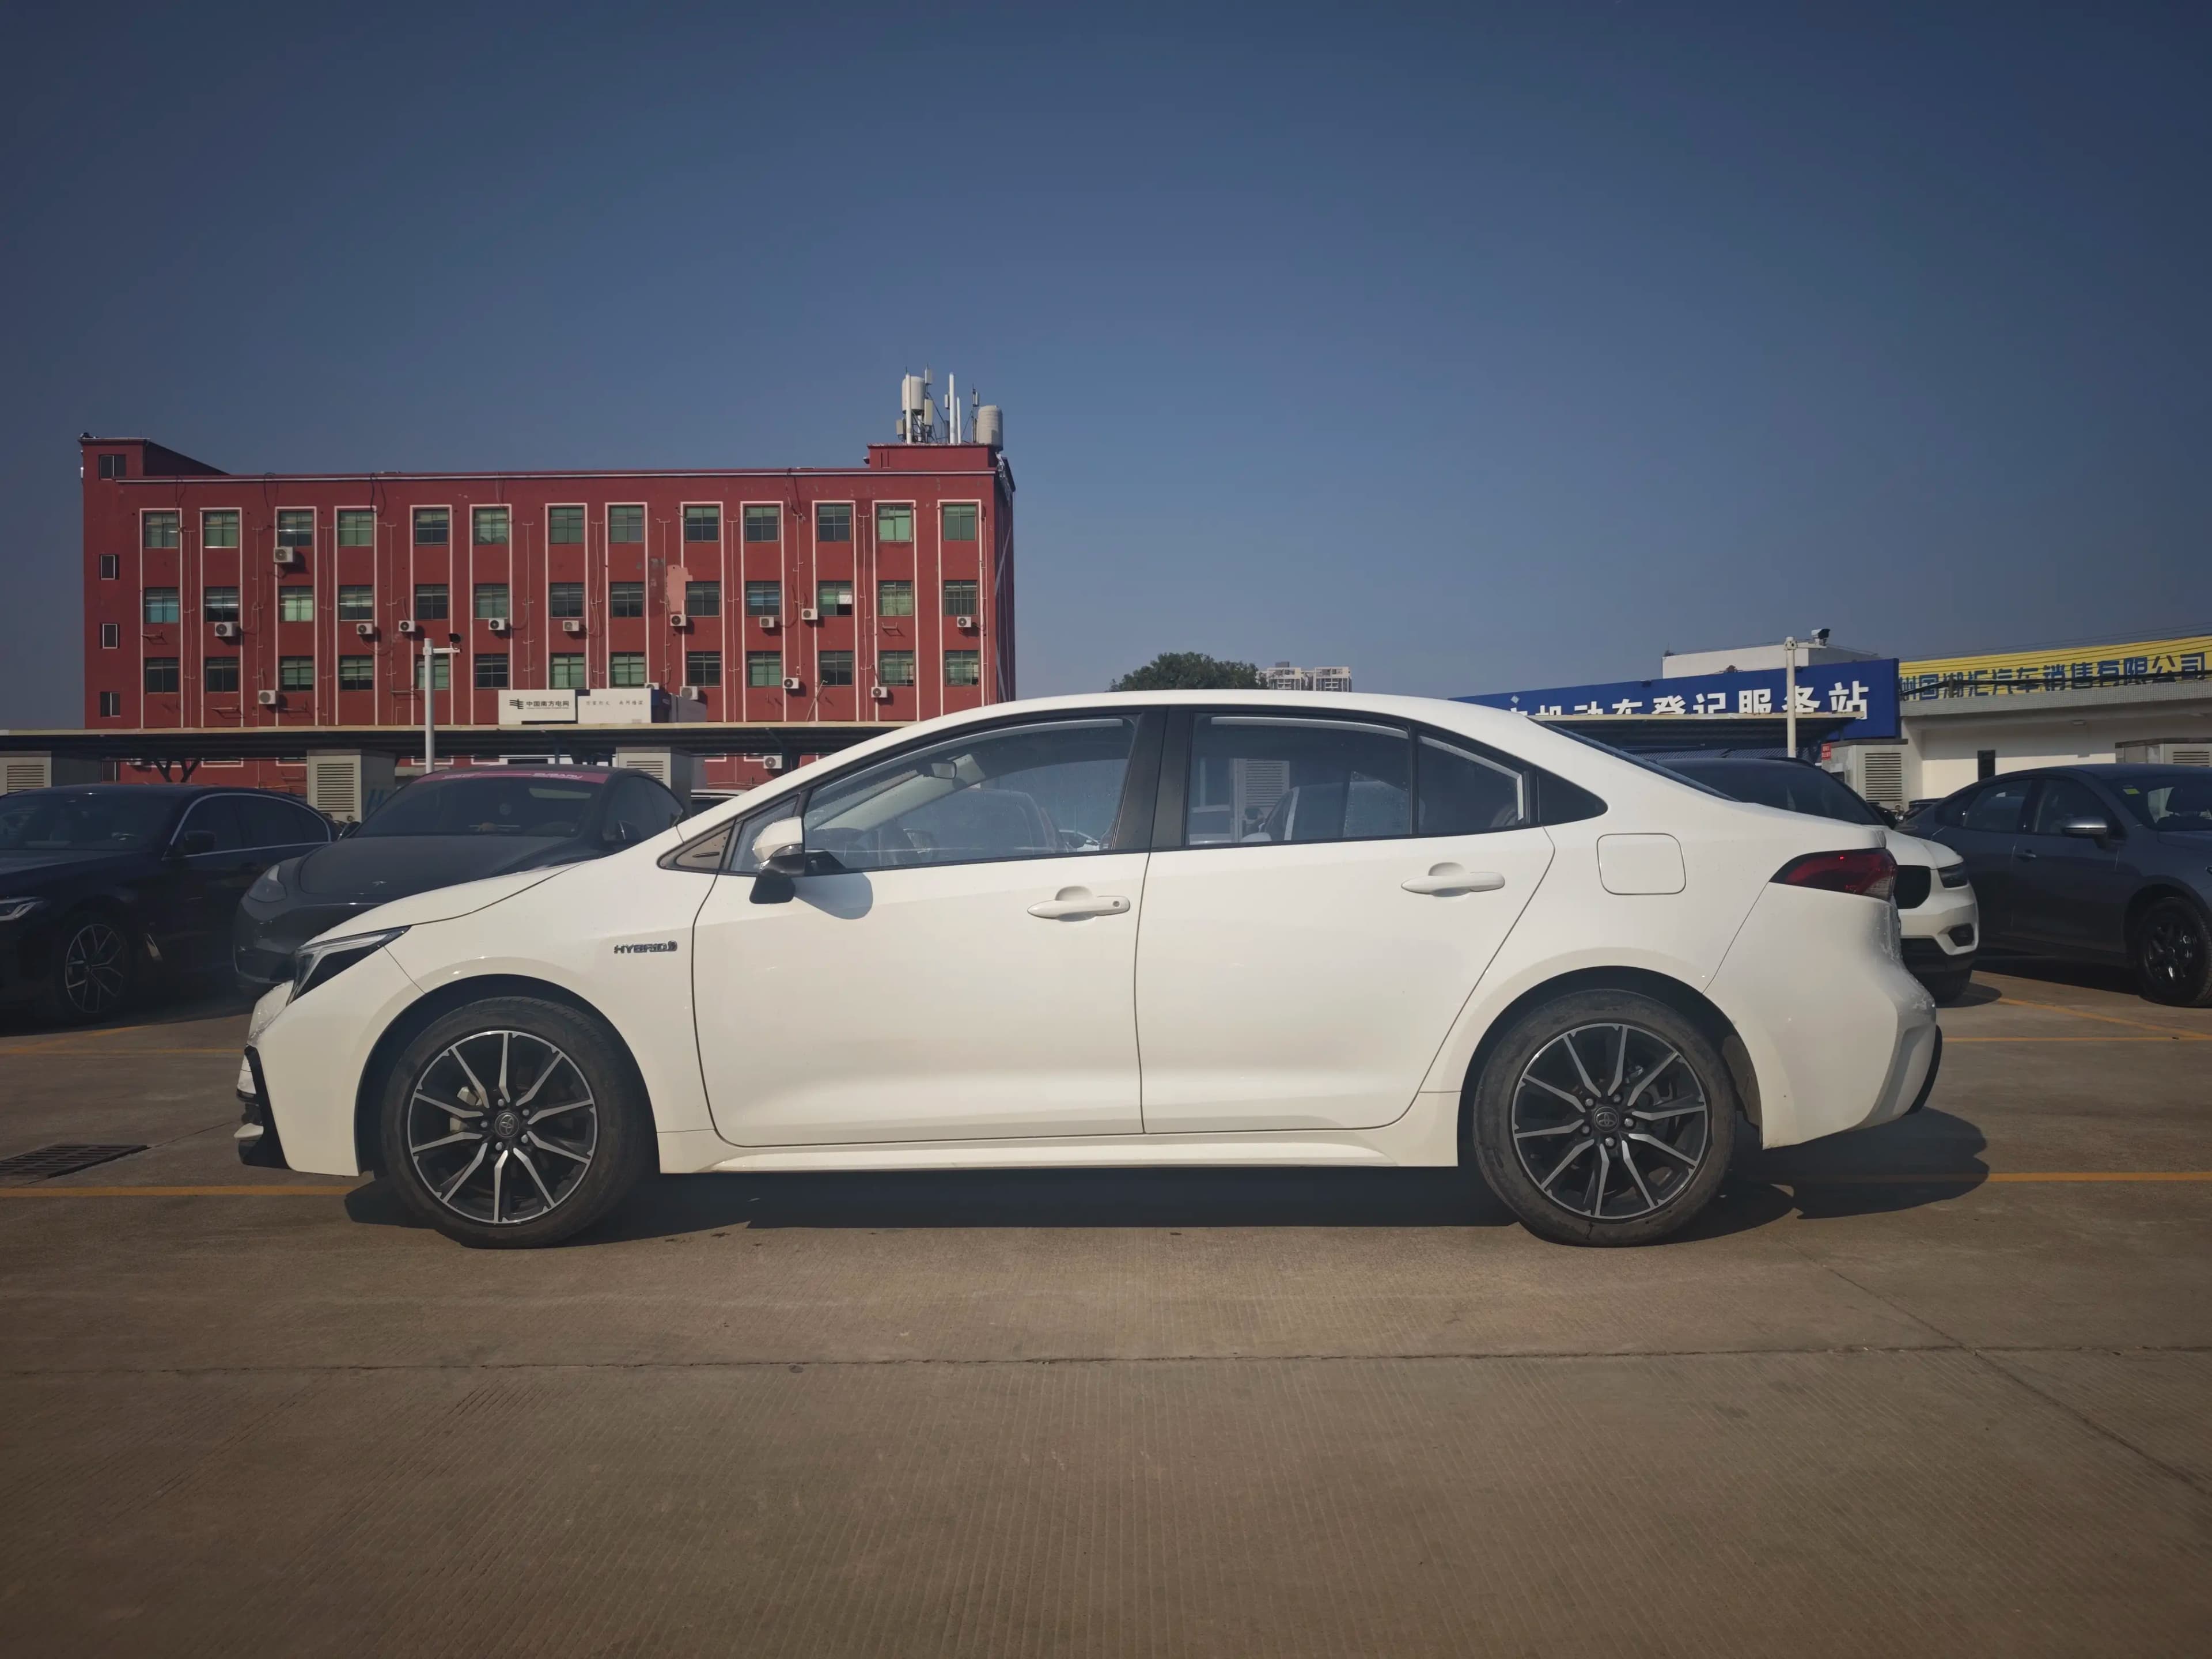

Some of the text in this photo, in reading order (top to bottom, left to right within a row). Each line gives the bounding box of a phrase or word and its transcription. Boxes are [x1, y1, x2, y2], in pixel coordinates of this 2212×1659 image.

[1510, 680, 1869, 720] 车登记服务站
[613, 942, 668, 954] HYBRID
